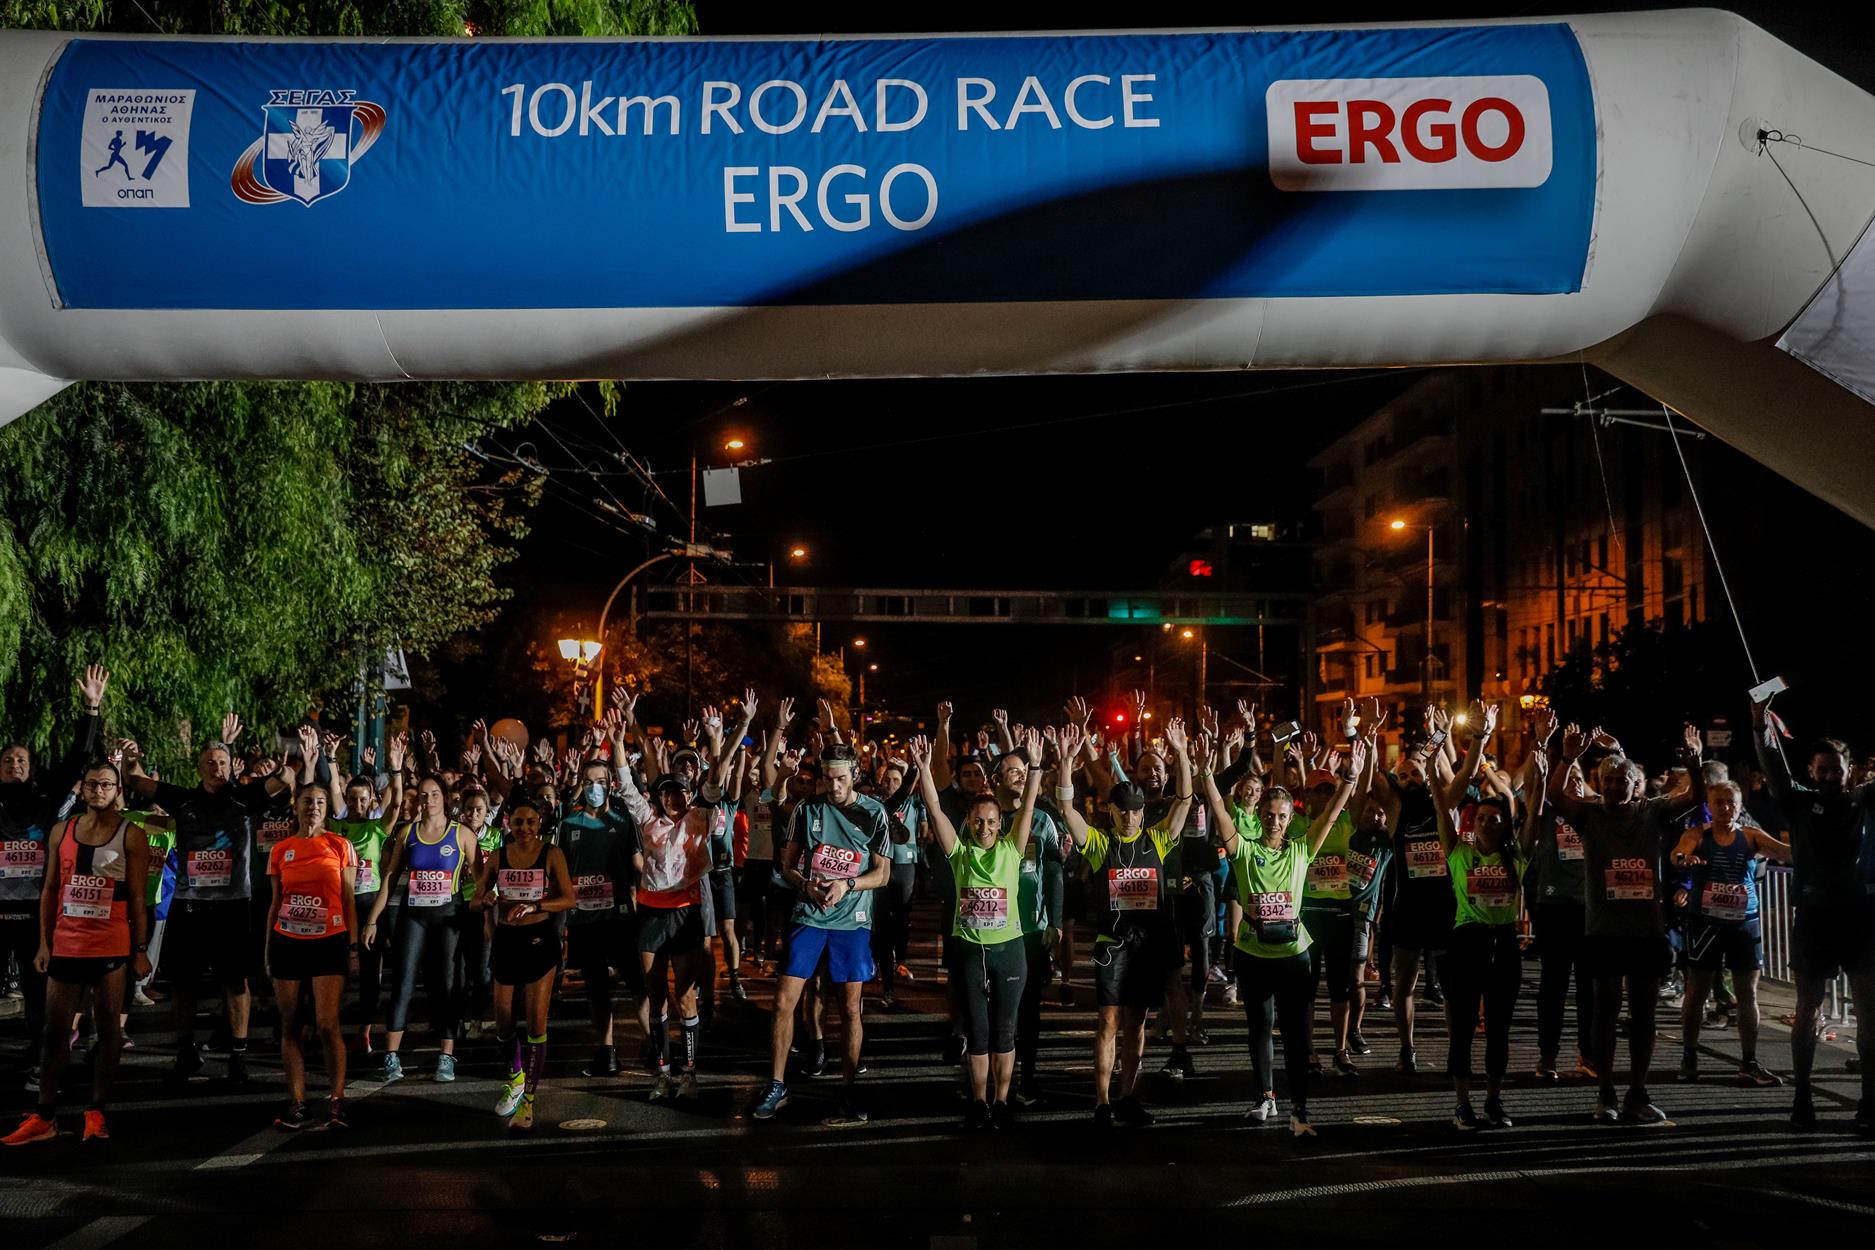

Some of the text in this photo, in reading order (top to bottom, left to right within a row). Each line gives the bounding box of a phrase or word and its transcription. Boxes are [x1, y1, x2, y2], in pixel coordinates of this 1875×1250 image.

[268, 89, 357, 106] ΣΕΓΑΣ
[110, 106, 168, 115] ΑΘΗΝΑΣ
[500, 73, 1162, 138] 10km ROAD RACE
[1293, 97, 1527, 165] ERGO
[722, 162, 940, 234] ERGO
[263, 820, 290, 830] ERGO
[3, 840, 38, 851] ERGO
[1410, 840, 1441, 852] ERGO
[5, 851, 37, 862] 46138
[194, 850, 227, 861] ERGO
[821, 844, 855, 862] ERGO
[1413, 851, 1441, 862] 46128
[195, 860, 225, 872] 46262
[819, 857, 851, 873] 46264
[1312, 855, 1340, 866] ERGO
[1611, 858, 1647, 869] ERGO
[416, 870, 445, 880] ERGO
[504, 871, 534, 882] 46113
[1115, 868, 1150, 879] ERGO
[1615, 870, 1646, 882] 46214
[70, 874, 106, 888] ERGO
[577, 874, 605, 886] ERGO
[1119, 880, 1149, 892] 46185
[417, 881, 443, 892] 46331
[1711, 882, 1742, 895] ERGO
[70, 887, 102, 901] 46151
[967, 888, 1000, 899] ERGO
[1252, 892, 1285, 904] ERGO
[290, 894, 322, 907] ERGO
[967, 900, 998, 912] 46212
[288, 907, 318, 919] 46275
